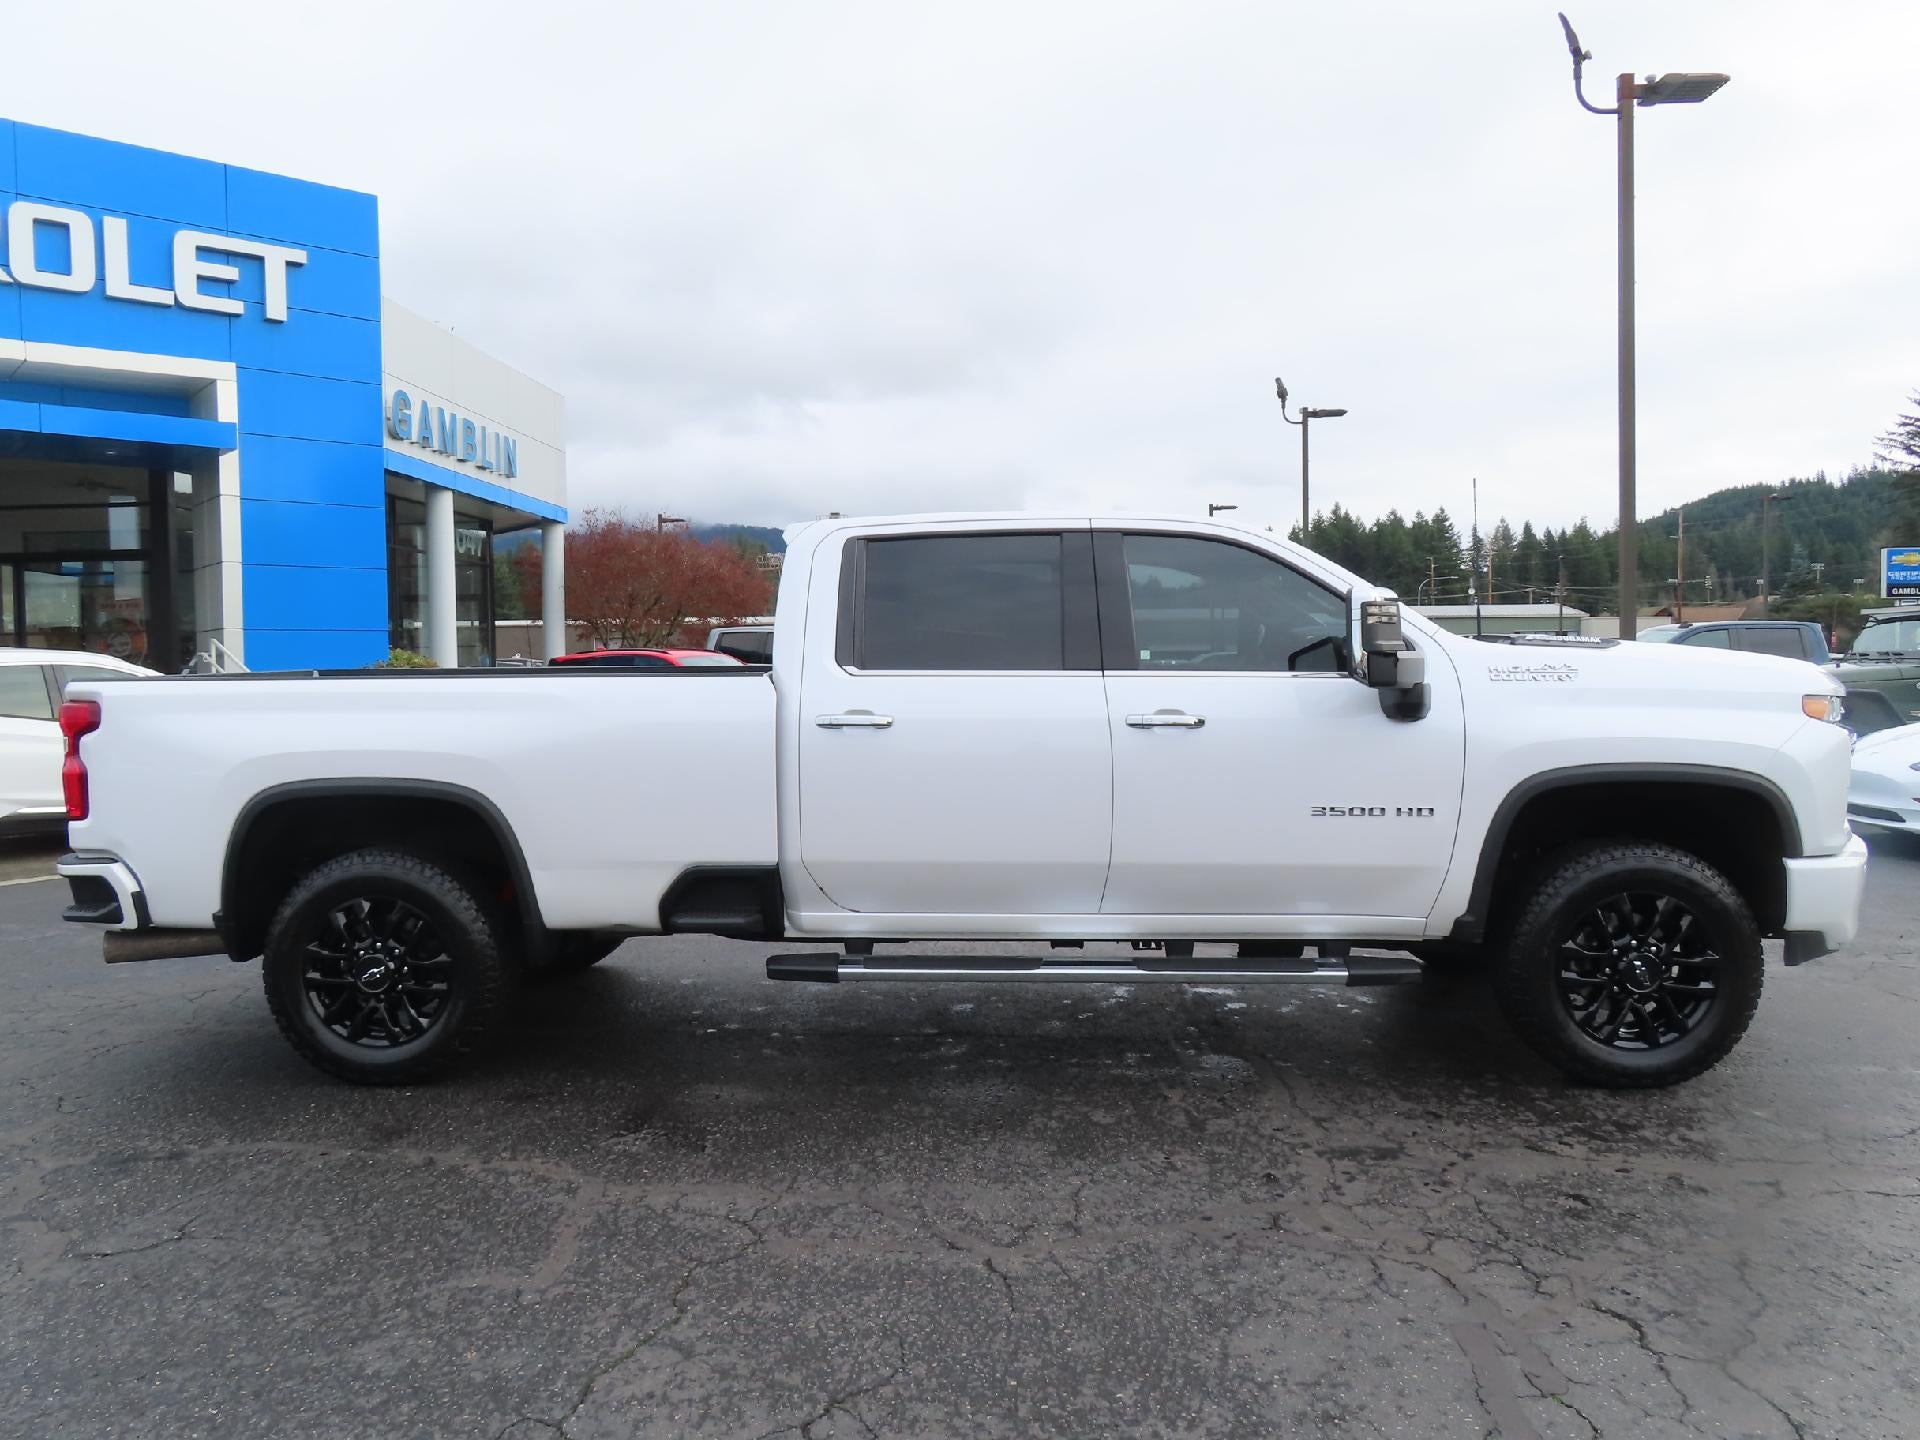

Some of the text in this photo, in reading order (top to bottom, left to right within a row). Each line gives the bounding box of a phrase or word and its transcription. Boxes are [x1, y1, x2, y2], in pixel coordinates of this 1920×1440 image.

[0, 201, 308, 323] OLET
[388, 389, 517, 479] GAMBLIN
[1488, 664, 1531, 673] HIGH
[1489, 673, 1578, 682] COUNTRY
[1310, 806, 1435, 817] 3500 HD
